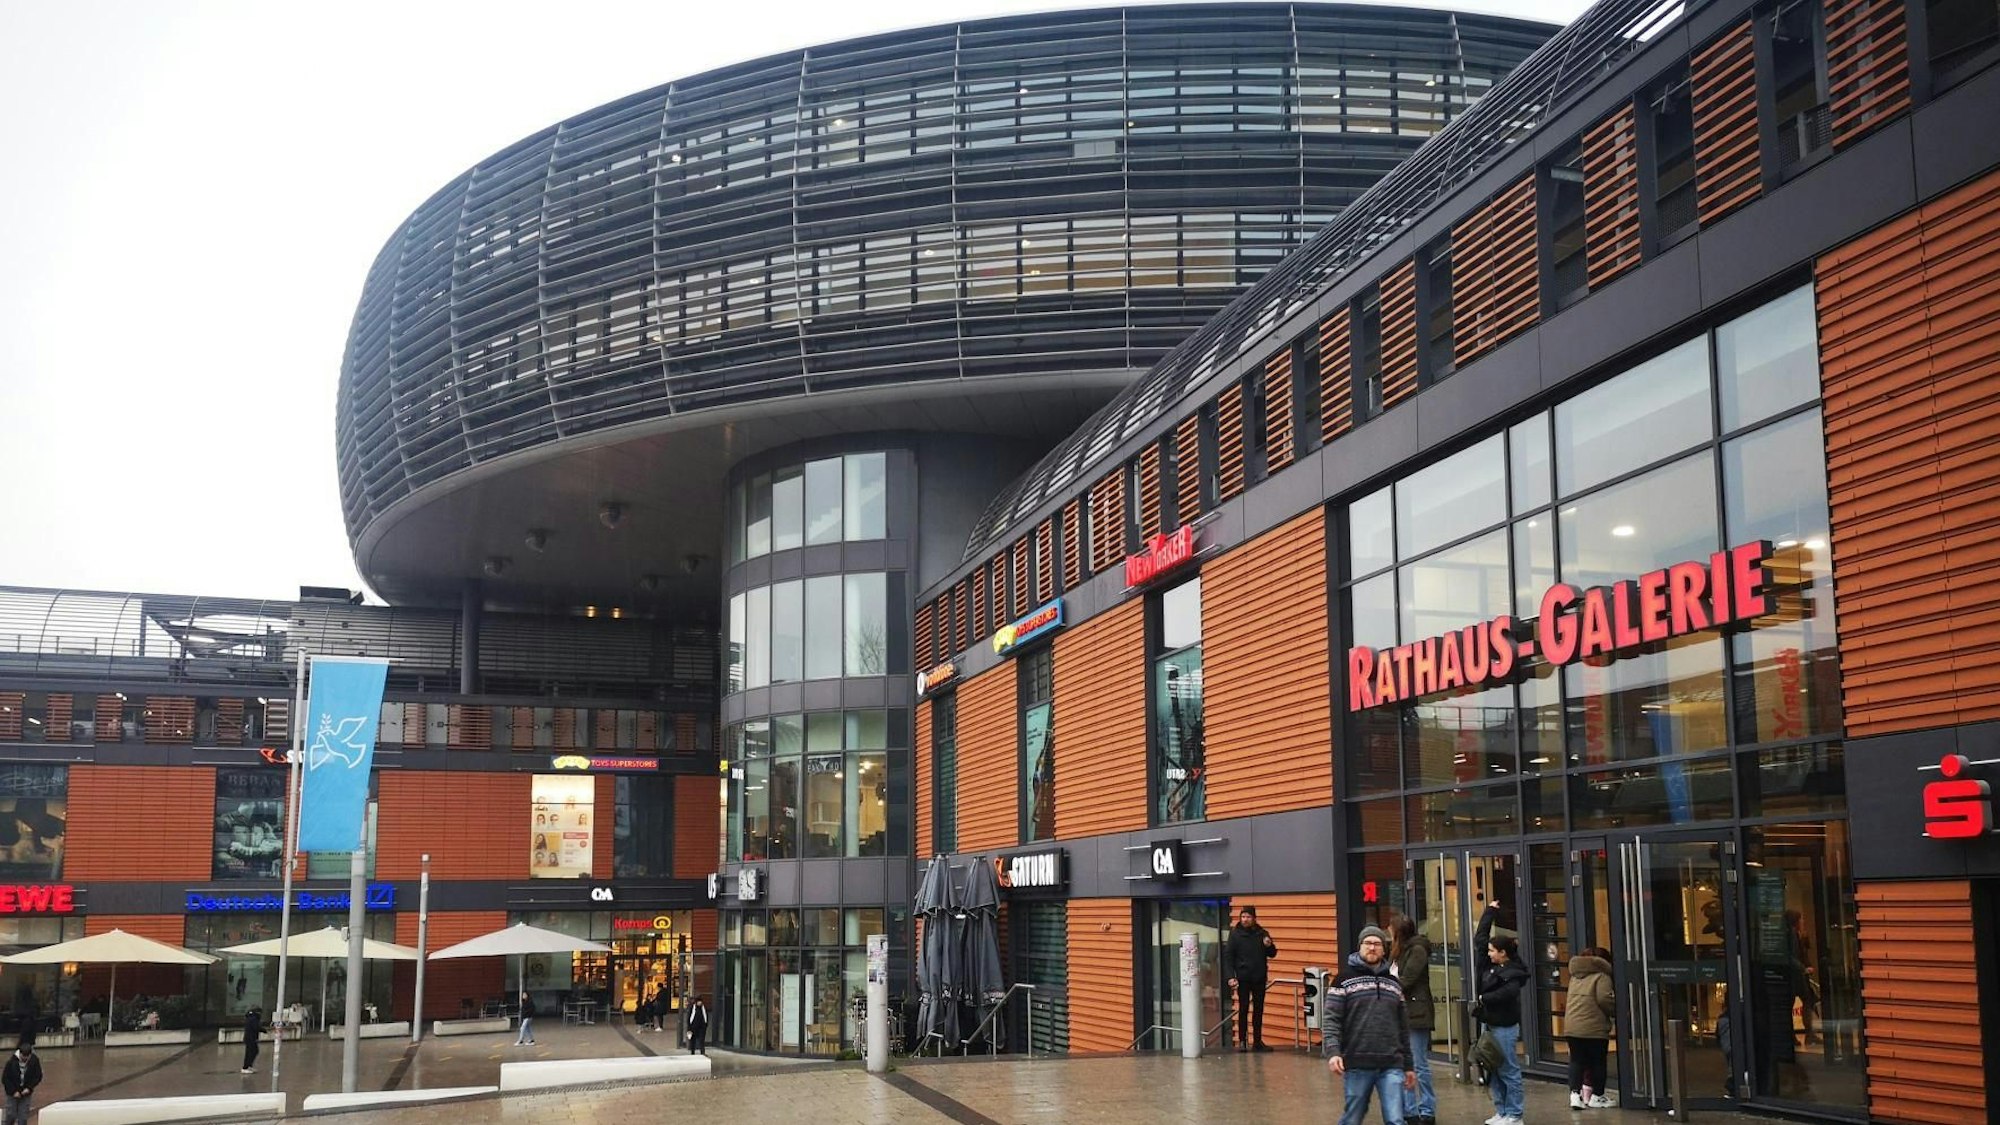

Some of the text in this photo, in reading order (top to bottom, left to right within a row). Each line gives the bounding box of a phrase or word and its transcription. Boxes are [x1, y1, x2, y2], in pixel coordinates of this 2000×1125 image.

[1126, 525, 1189, 588] NEW YORKER
[1350, 540, 1768, 712] RATHAUS-GALERIE
[610, 759, 657, 768] SUPERSTORES
[1012, 853, 1054, 888] SATURN
[187, 892, 286, 911] Deutsch
